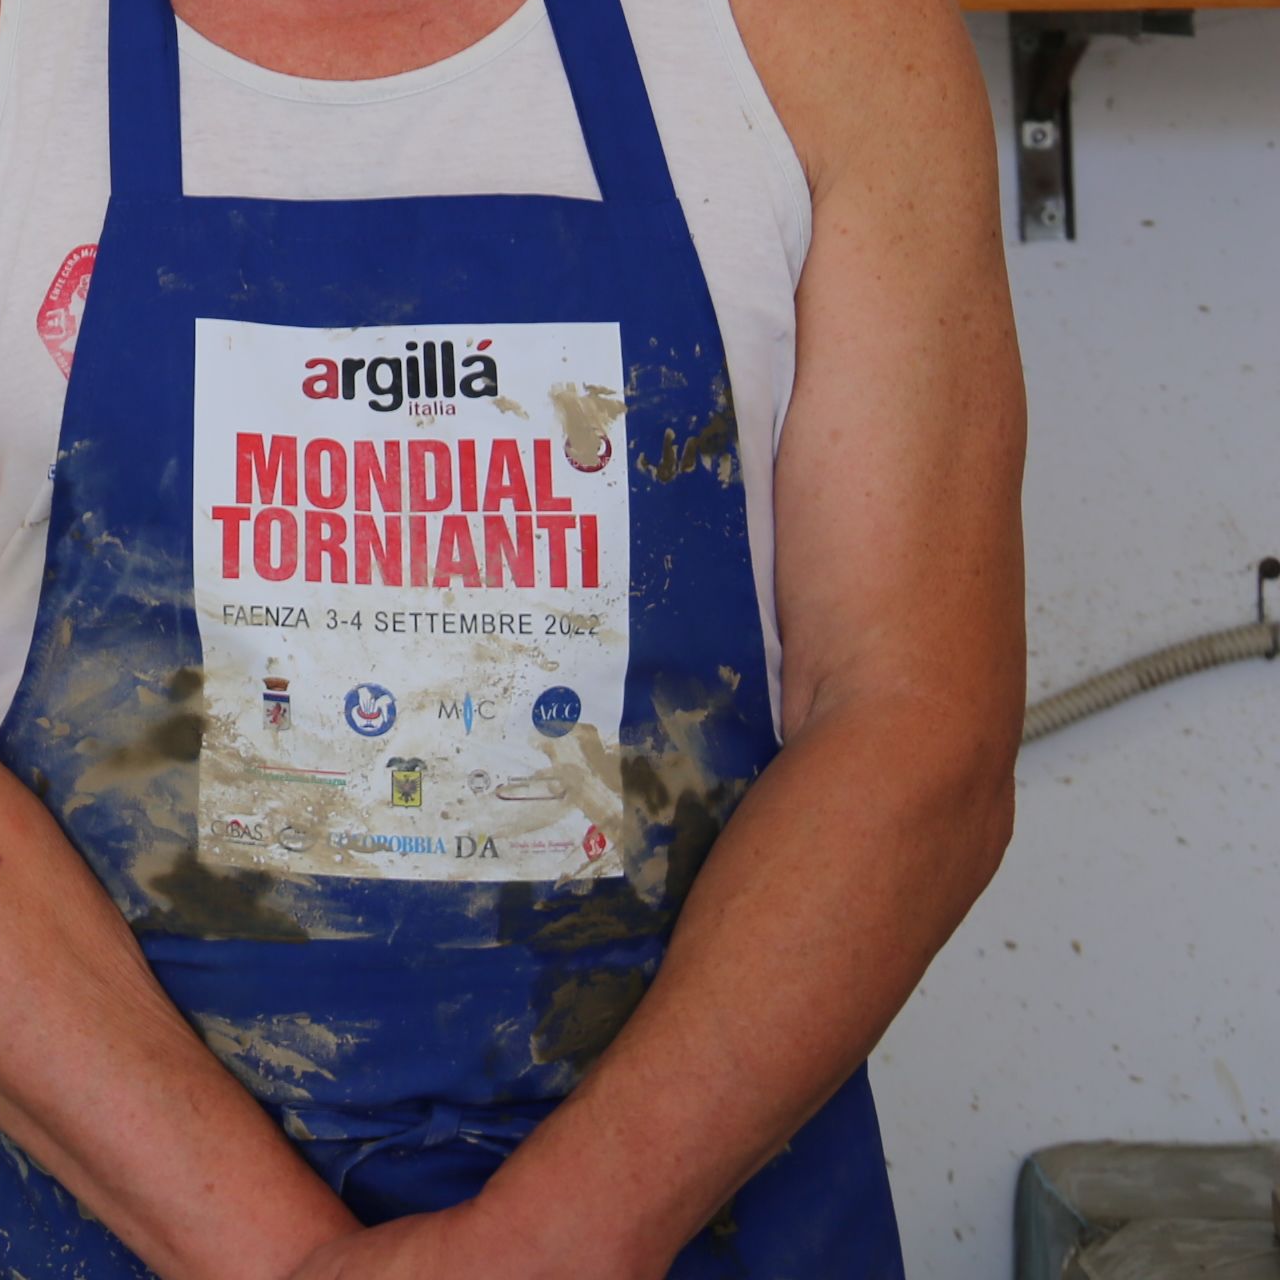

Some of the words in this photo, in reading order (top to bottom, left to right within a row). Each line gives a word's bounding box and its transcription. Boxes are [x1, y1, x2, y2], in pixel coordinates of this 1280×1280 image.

[408, 401, 456, 416] italia
[236, 432, 571, 512] MONDIAL
[212, 506, 600, 589] TORNIANTI
[223, 605, 310, 628] FAENZA
[326, 609, 363, 631] 3-4
[374, 611, 534, 635] SETTEMBRE
